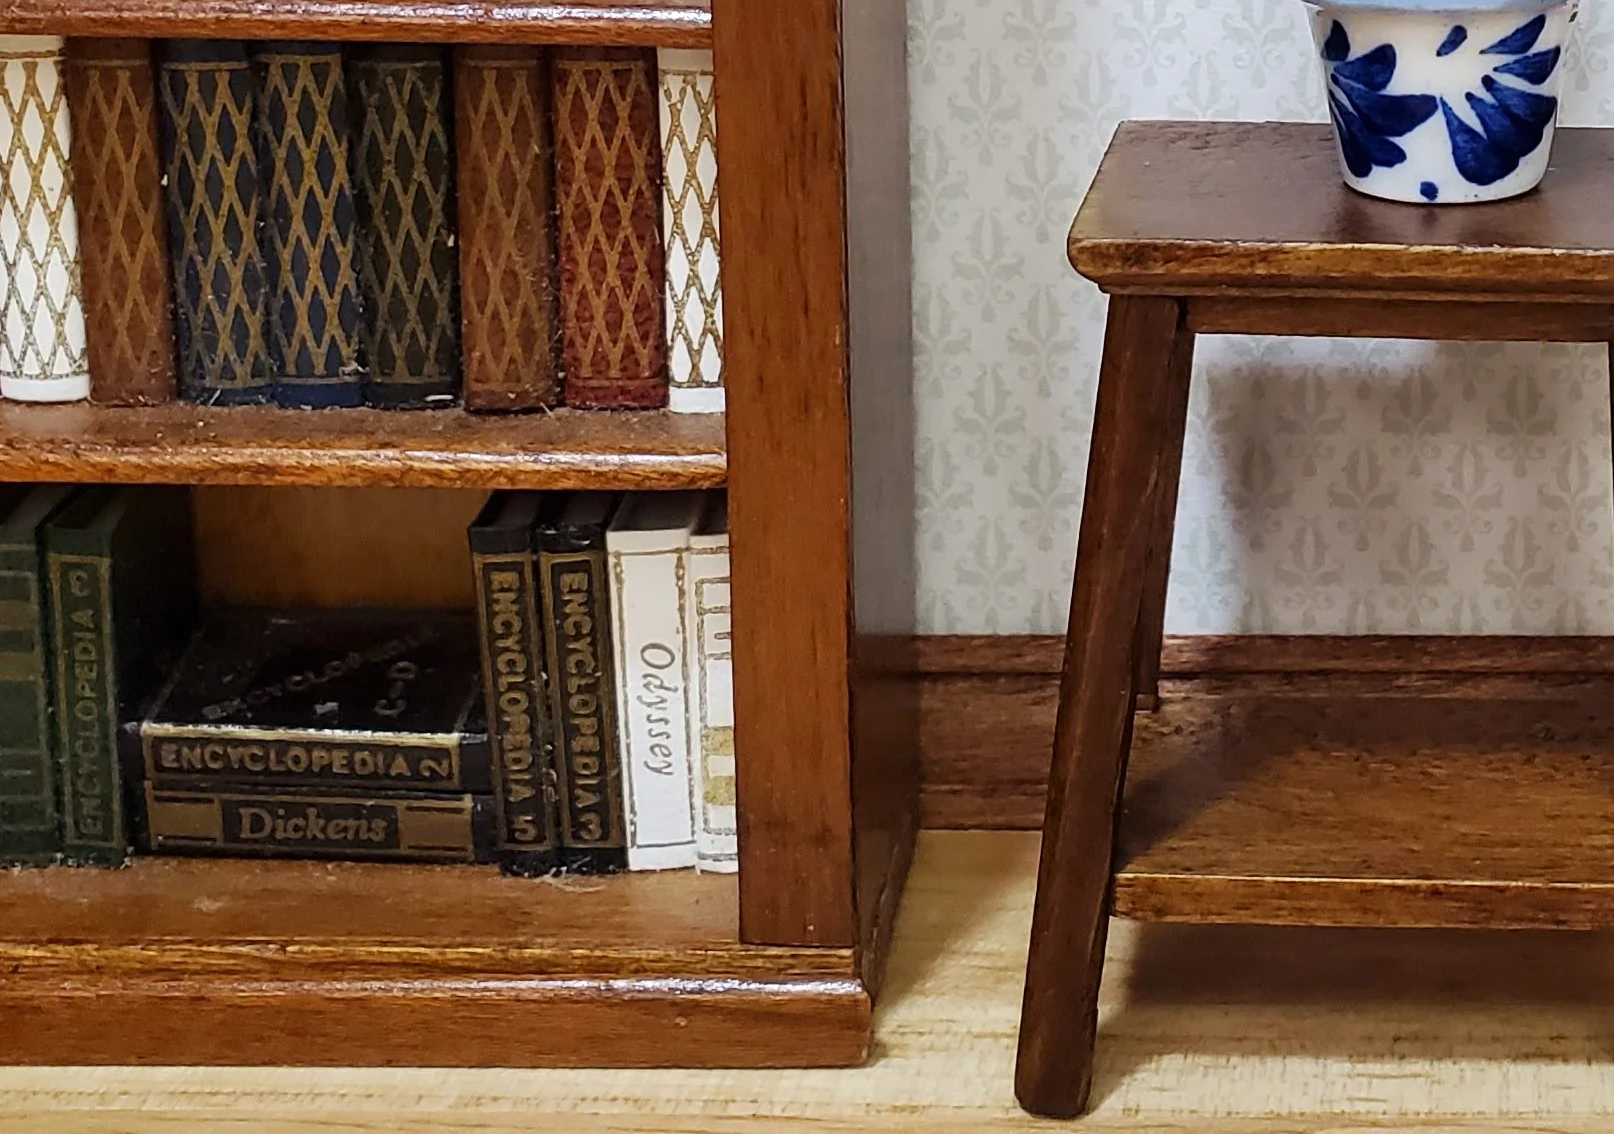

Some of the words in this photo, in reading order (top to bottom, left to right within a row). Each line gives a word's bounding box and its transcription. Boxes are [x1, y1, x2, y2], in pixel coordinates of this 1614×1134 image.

[159, 742, 411, 777] ENCYCLOPEDIA
[490, 572, 535, 802] ENCYCLOPEDIA
[514, 815, 537, 842] 5
[560, 572, 600, 808] ENCYCLOPEDIA
[580, 812, 601, 840] 3
[637, 642, 678, 776] Odyssey
[238, 807, 388, 843] Dickens
